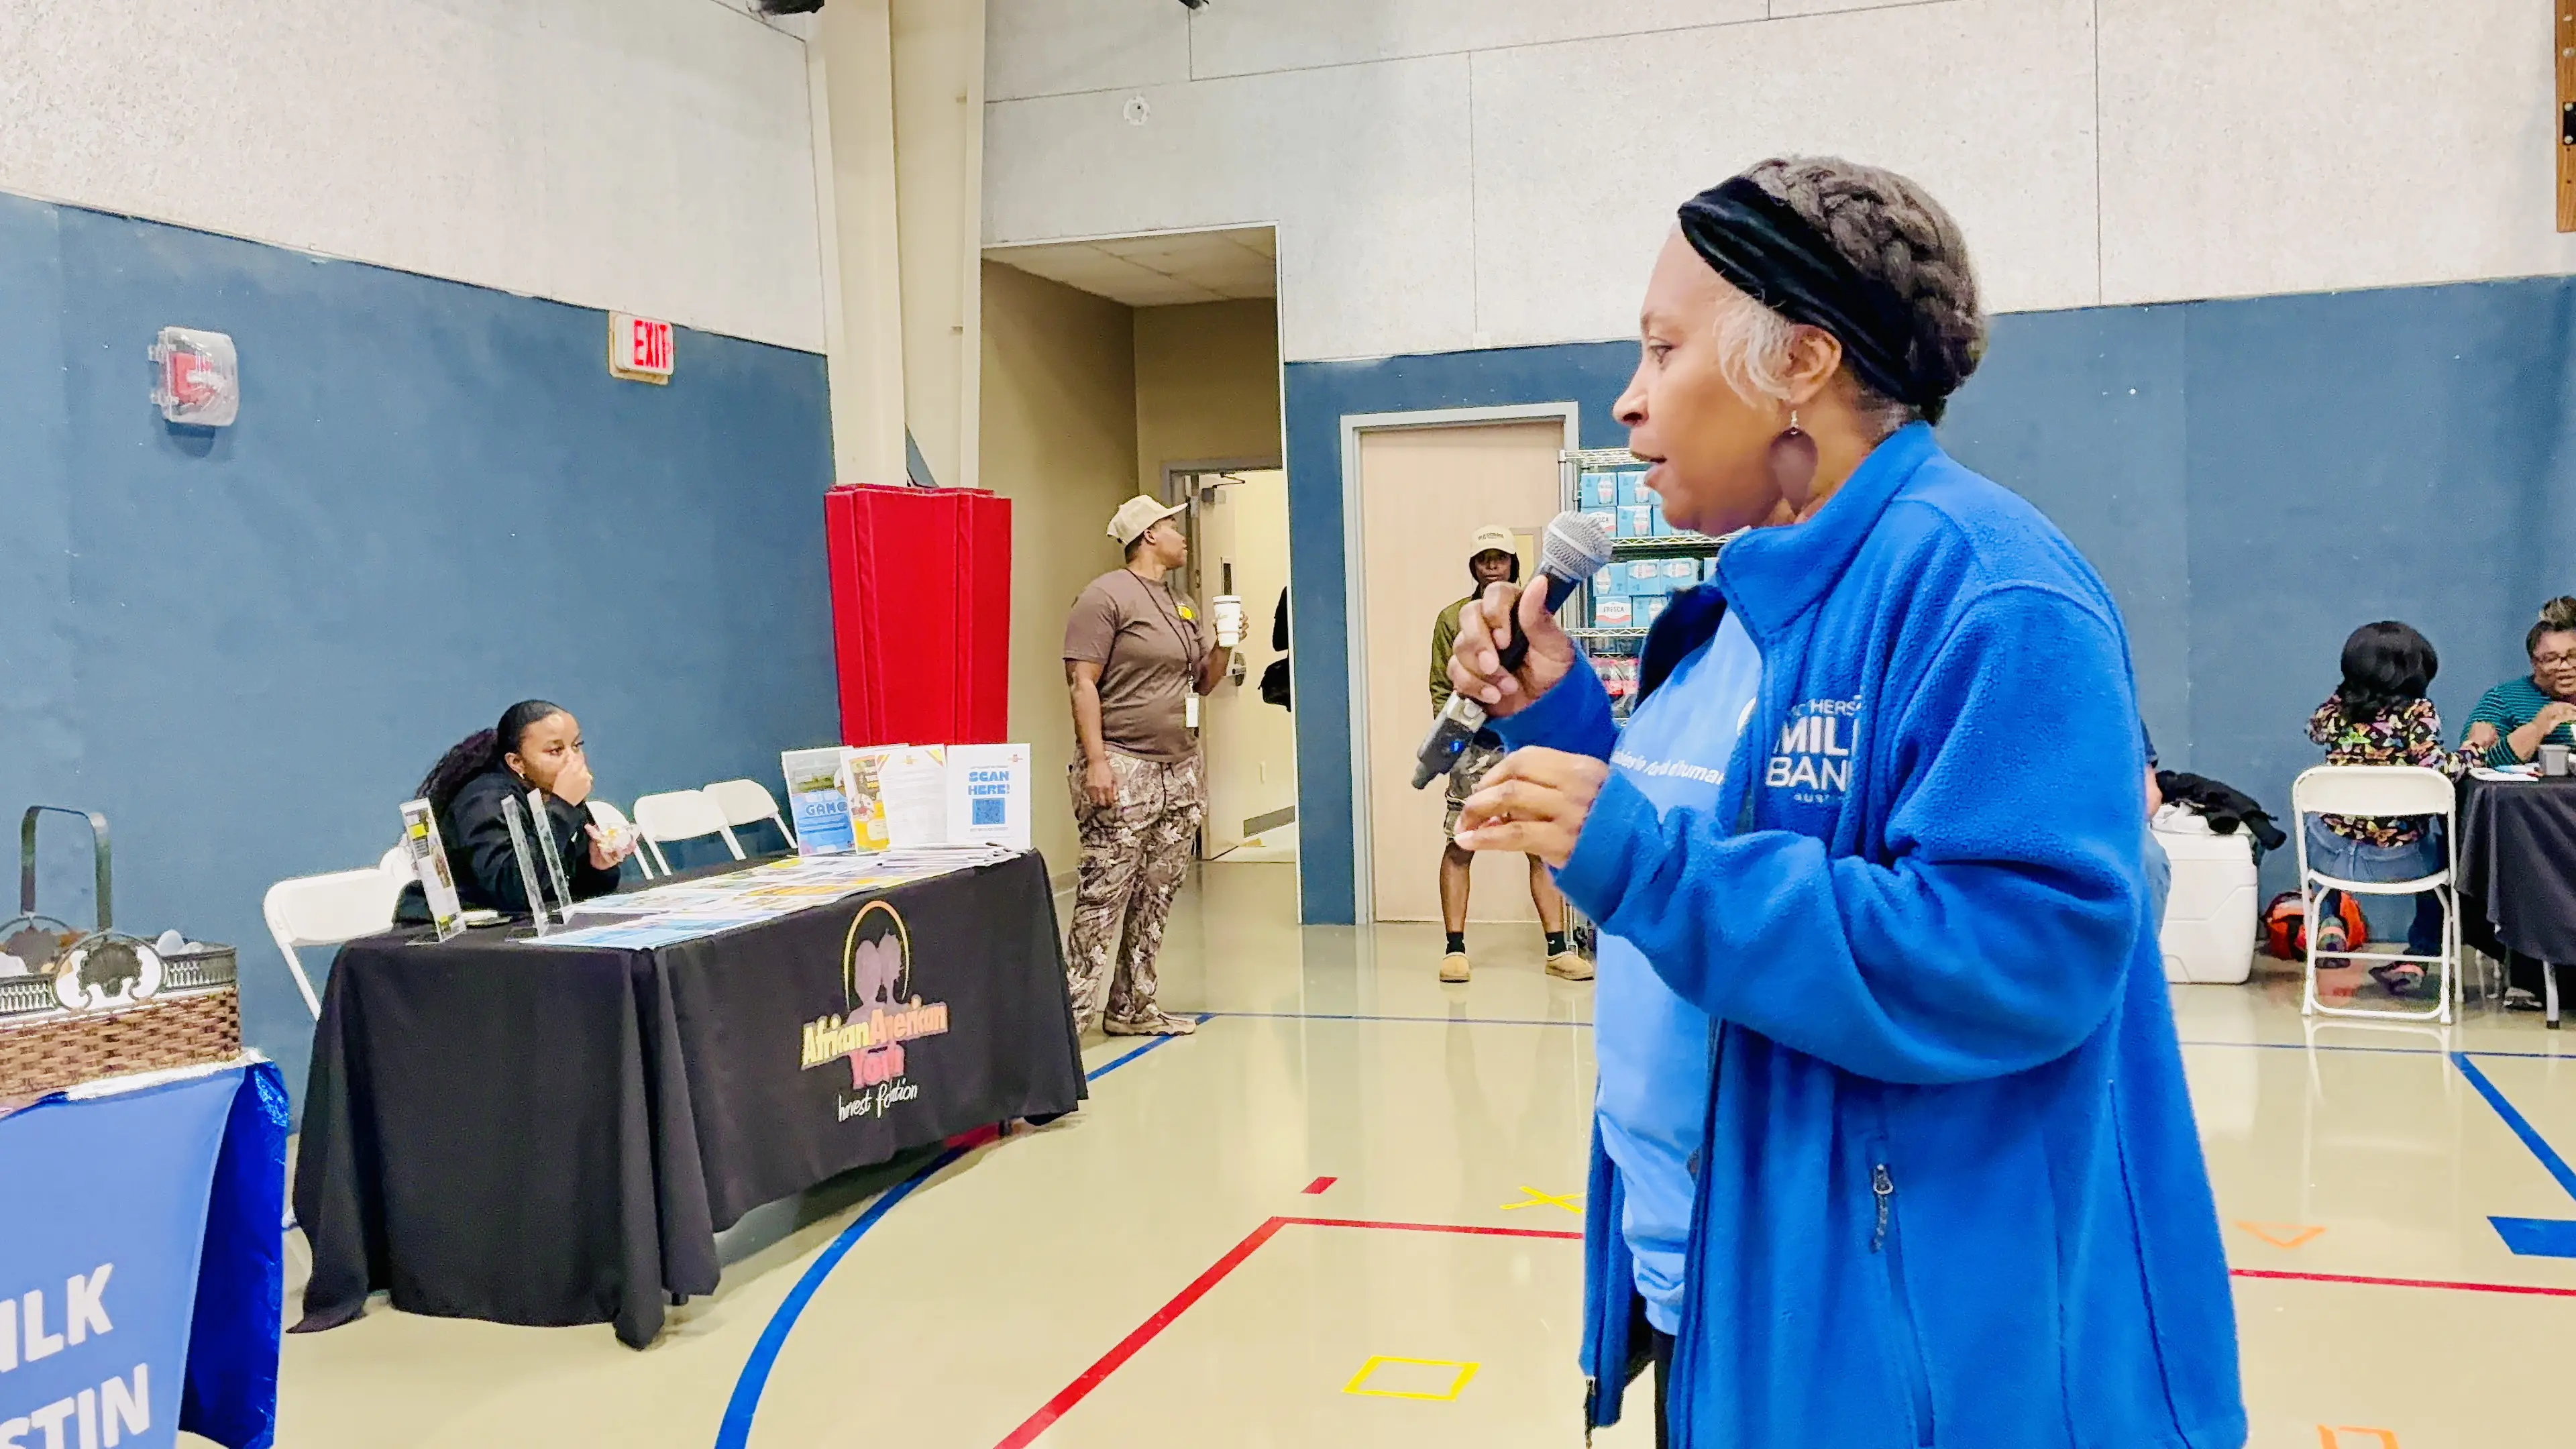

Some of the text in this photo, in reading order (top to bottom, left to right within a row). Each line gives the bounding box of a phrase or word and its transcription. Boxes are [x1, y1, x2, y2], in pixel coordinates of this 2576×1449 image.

[634, 319, 668, 368] EXIT
[969, 771, 1010, 782] SCAN
[1766, 756, 1852, 792] BAN
[968, 784, 1010, 795] HERE!
